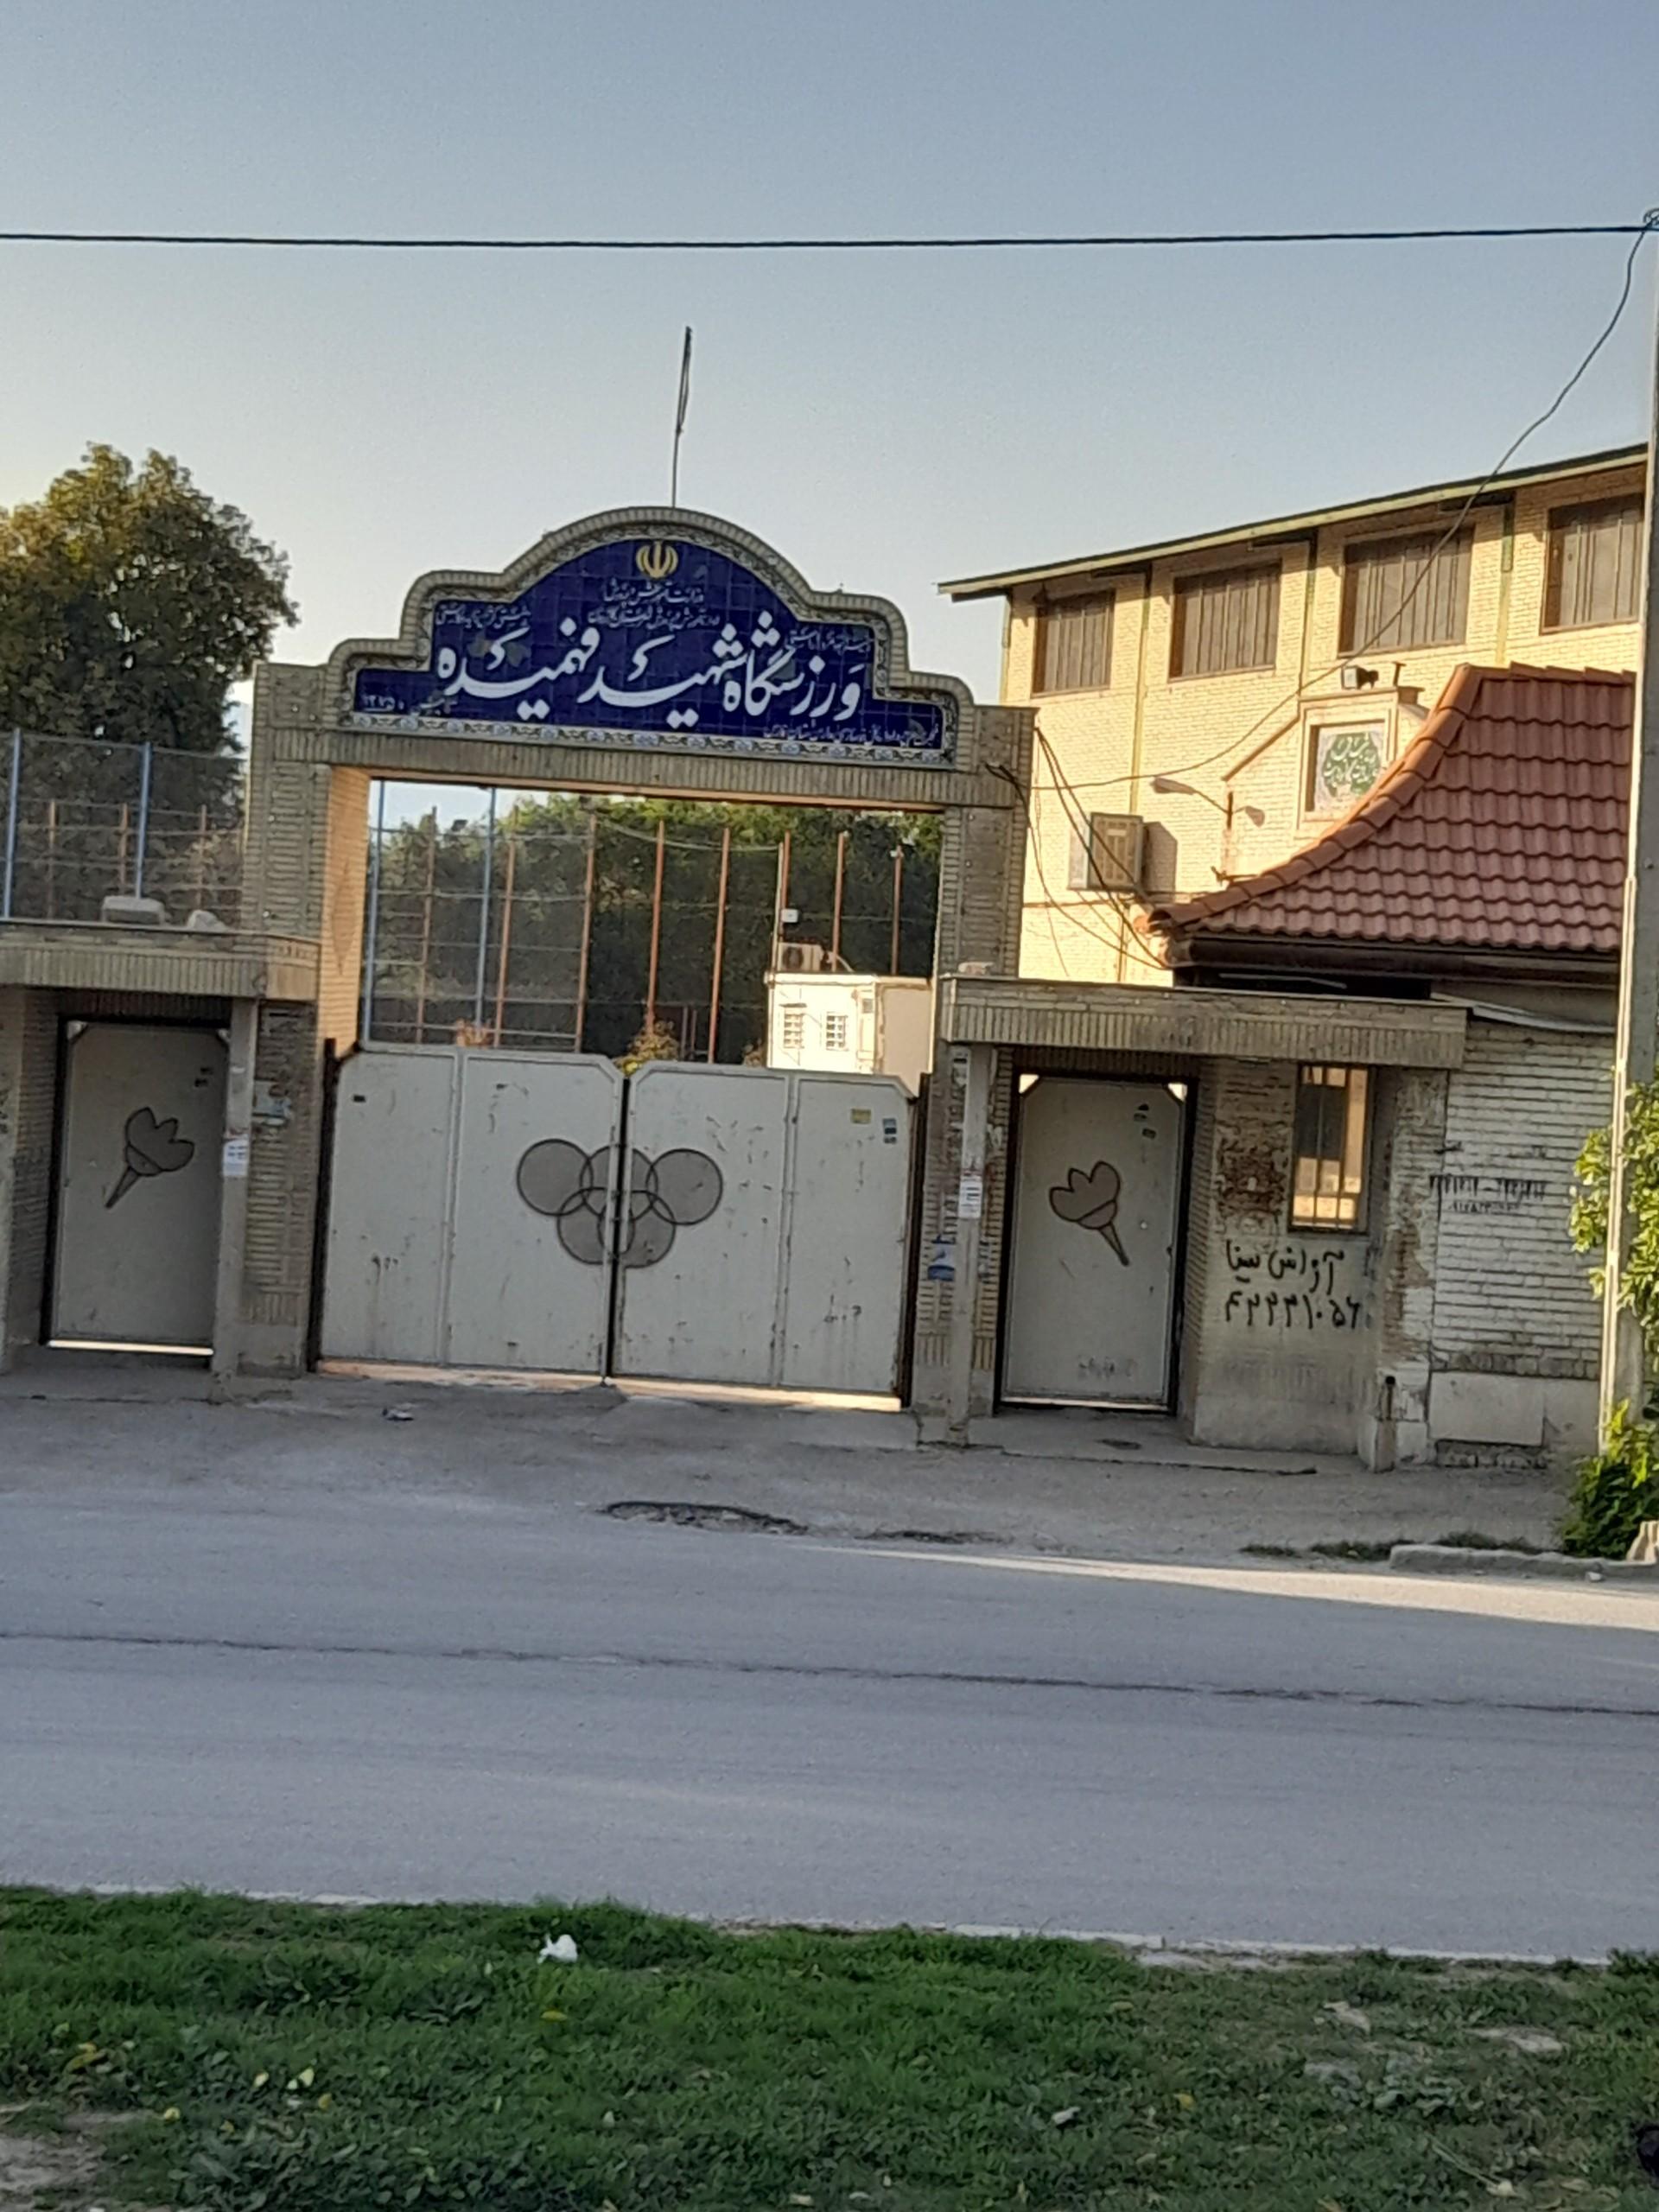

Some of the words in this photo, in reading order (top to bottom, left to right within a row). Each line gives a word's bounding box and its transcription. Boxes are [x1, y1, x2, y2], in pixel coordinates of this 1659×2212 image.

[437, 617, 601, 721] فهمیده
[576, 623, 748, 728] شهید
[722, 610, 865, 721] ورزشگاه
[1226, 1239, 1260, 1283] سینا
